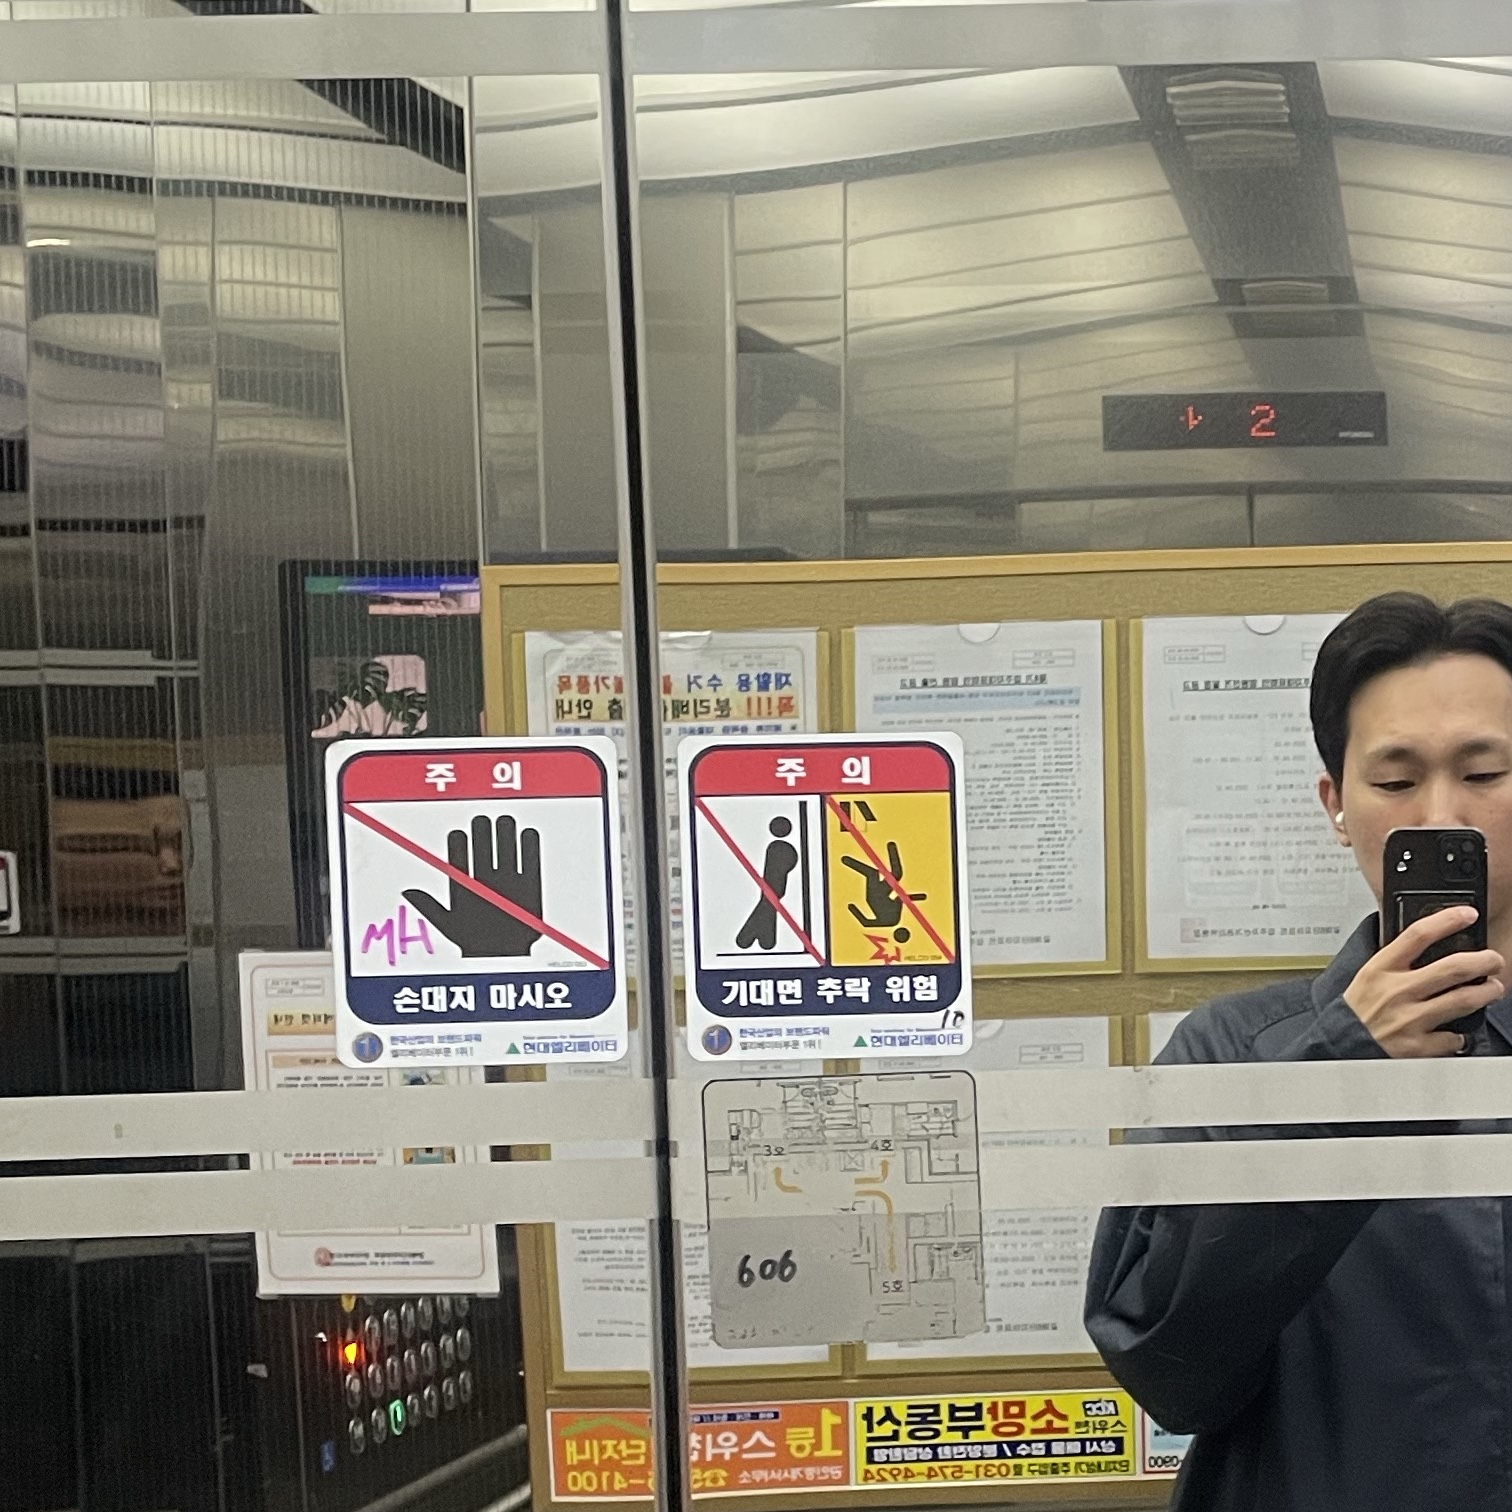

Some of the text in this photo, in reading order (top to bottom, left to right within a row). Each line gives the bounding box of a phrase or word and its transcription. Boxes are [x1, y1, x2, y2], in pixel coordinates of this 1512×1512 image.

[1250, 405, 1276, 437] 2
[425, 761, 522, 792] 주 의
[775, 755, 871, 787] 주 의
[361, 905, 434, 966] MH
[393, 981, 573, 1014] 손대지 마시오
[721, 975, 939, 1008] 기대면 추락 위험
[523, 1040, 618, 1055] 현대엘리베이터
[871, 1033, 963, 1048] 현대엘리베이터
[738, 1249, 798, 1288] 606
